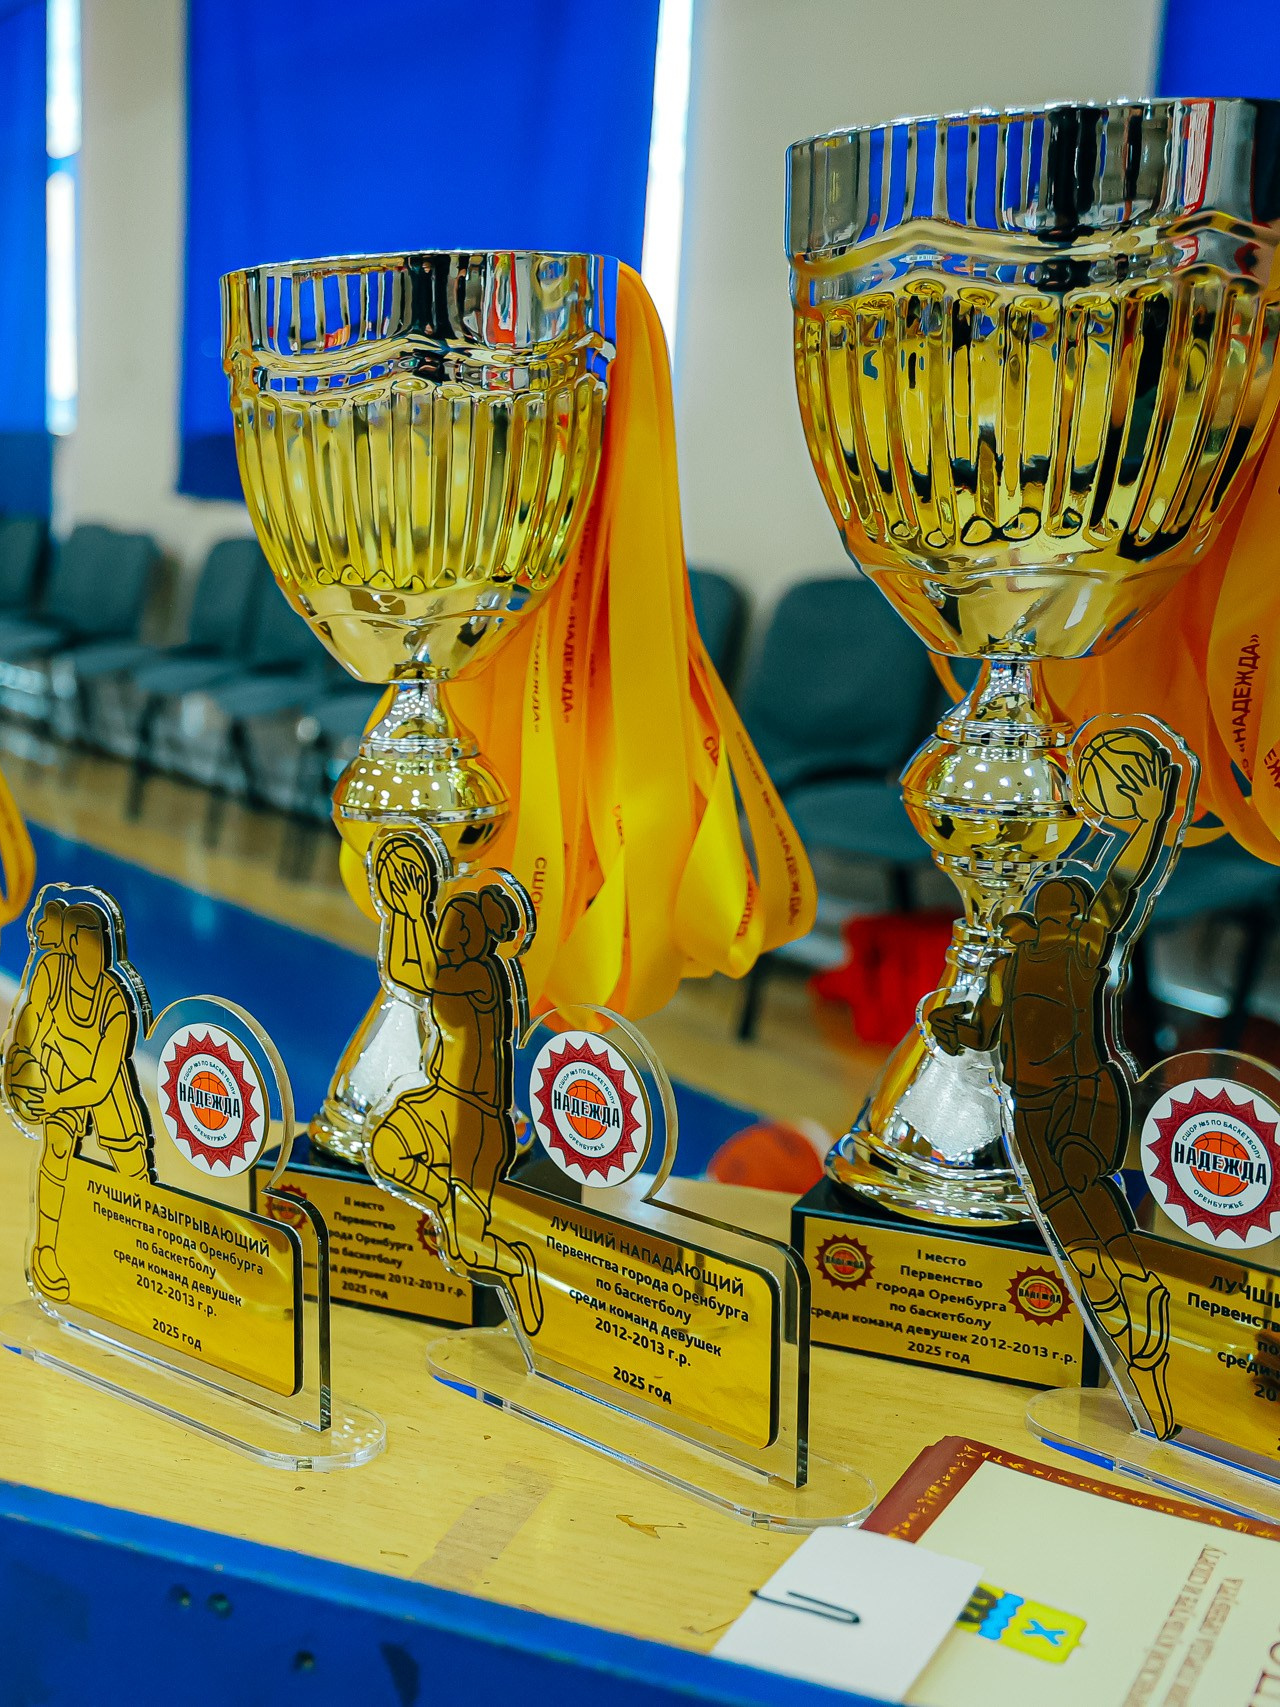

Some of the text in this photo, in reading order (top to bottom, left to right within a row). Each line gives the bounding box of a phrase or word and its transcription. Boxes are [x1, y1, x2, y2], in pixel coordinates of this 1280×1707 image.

[1232, 634, 1261, 753] «НАДЕЖДА»
[180, 1082, 240, 1118] НАДЕЖДА
[554, 1090, 620, 1128] НАДЕЖДА
[1182, 1125, 1198, 1142] СШОР
[1223, 1121, 1262, 1159] БАСКЕТБОЛУ
[1174, 1142, 1267, 1185] НАДЕЖДА
[1194, 1189, 1244, 1209] ОРЕНБУРЖЬЕ
[87, 1180, 270, 1257] ЛУЧШИЙ РАЗЫГРЫВАЮЩИЙ
[93, 1201, 155, 1234] Первенства
[157, 1227, 197, 1249] города
[199, 1241, 264, 1275] Оренбурга
[550, 1216, 745, 1297] ЛУЧШИЙ НАПАДАЮЩИЙ
[113, 1249, 242, 1307] среди команд девушек
[136, 1239, 216, 1279] по баскетболу
[900, 1265, 983, 1288] Первенство
[925, 1252, 967, 1267] место
[136, 1274, 217, 1317] 2012-2013 г.р.
[342, 1280, 367, 1294] 2025
[388, 1273, 445, 1292] 2012-2013
[547, 1235, 749, 1322] Первенства города Оренбурга
[876, 1282, 1007, 1312] города Оренбурга
[596, 1278, 692, 1325] по баскетболу
[890, 1302, 992, 1330] по баскетболу
[153, 1318, 202, 1351] 2025 год
[569, 1289, 722, 1357] среди команд девушек
[595, 1317, 691, 1367] 2012-2013 г.р.
[852, 1314, 903, 1332] команд
[906, 1323, 968, 1343] девушек
[971, 1334, 1049, 1358] 2012-2013
[1052, 1350, 1078, 1365] г.р.
[907, 1341, 970, 1364] 2025 год
[1218, 1351, 1273, 1376] среди
[613, 1366, 672, 1404] 2025 год
